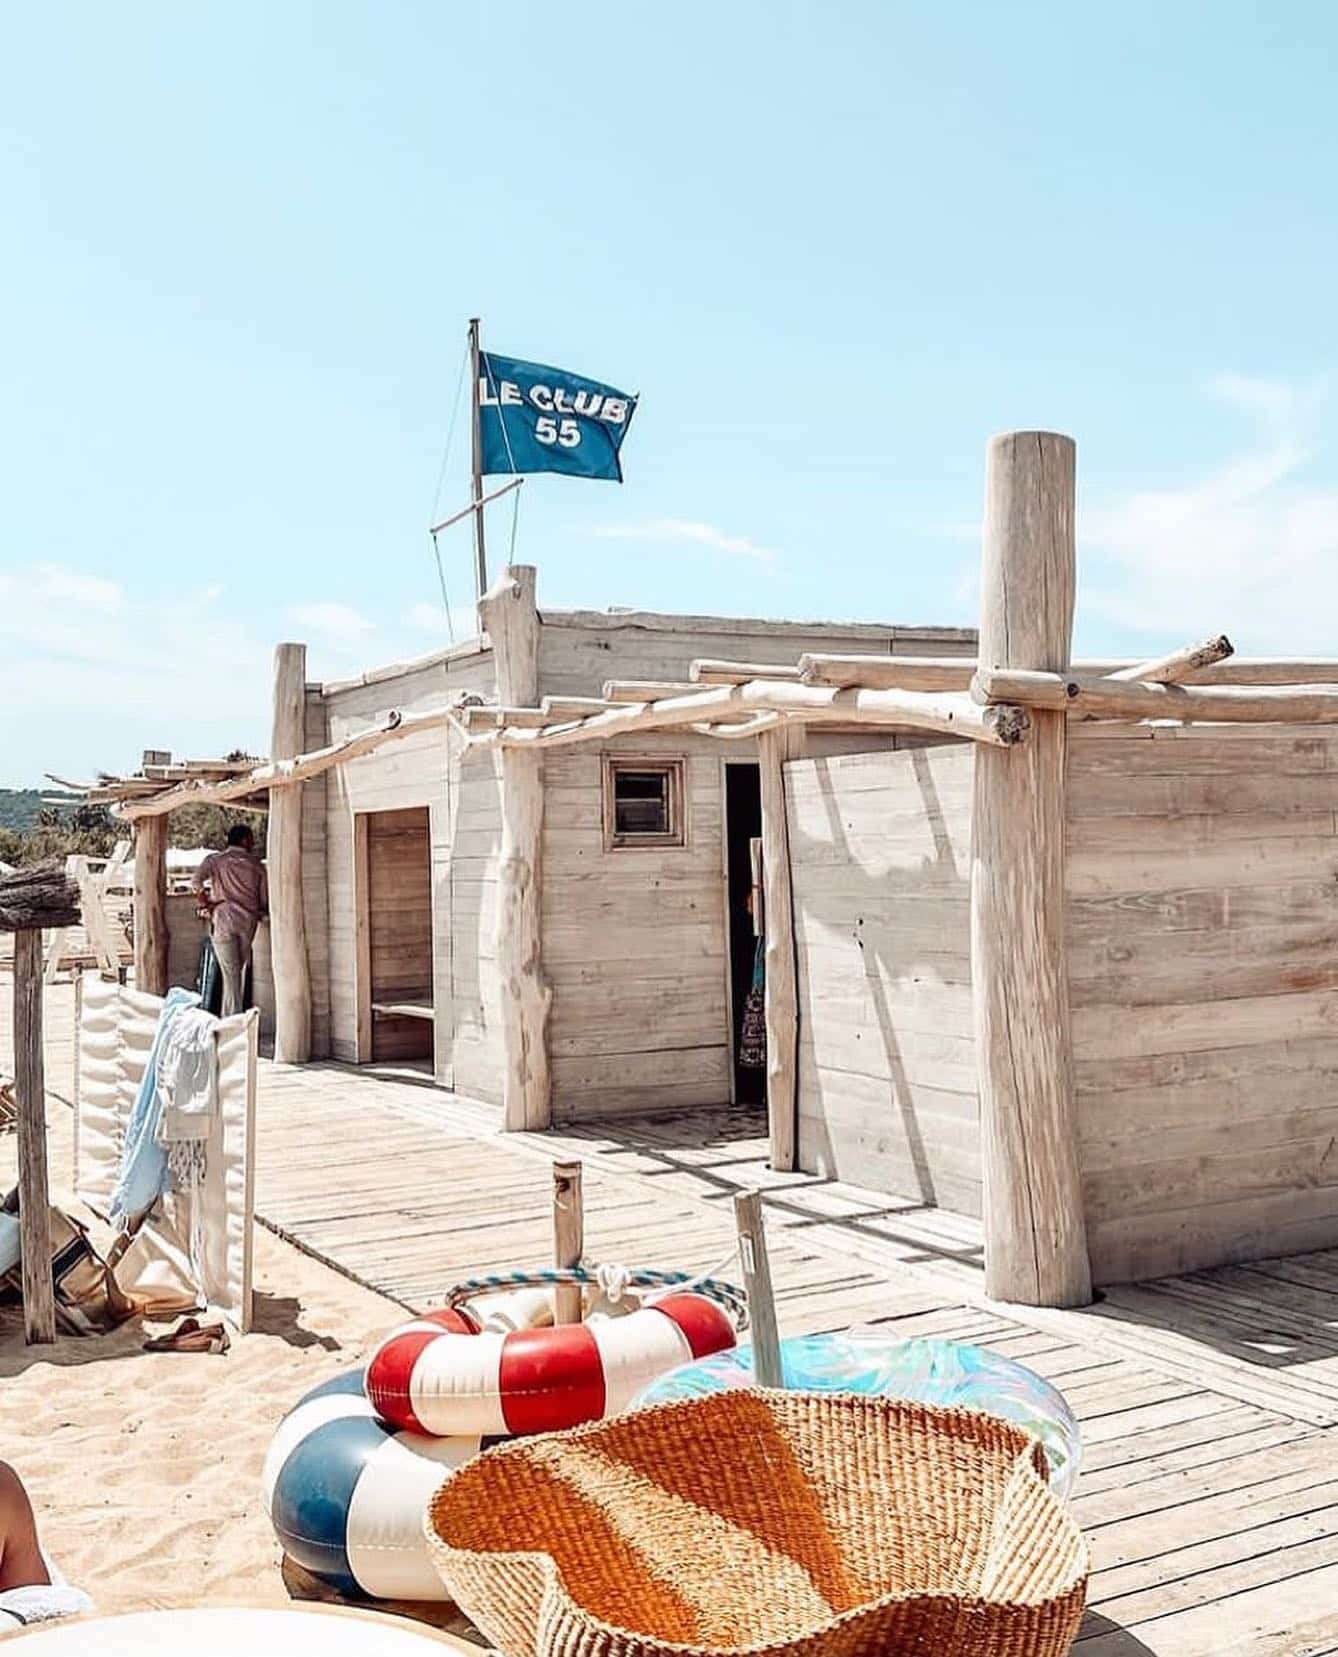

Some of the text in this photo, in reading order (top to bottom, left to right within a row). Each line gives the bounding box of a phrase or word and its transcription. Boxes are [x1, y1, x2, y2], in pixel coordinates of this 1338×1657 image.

[479, 377, 628, 424] LE CLUB
[535, 416, 581, 447] 55
